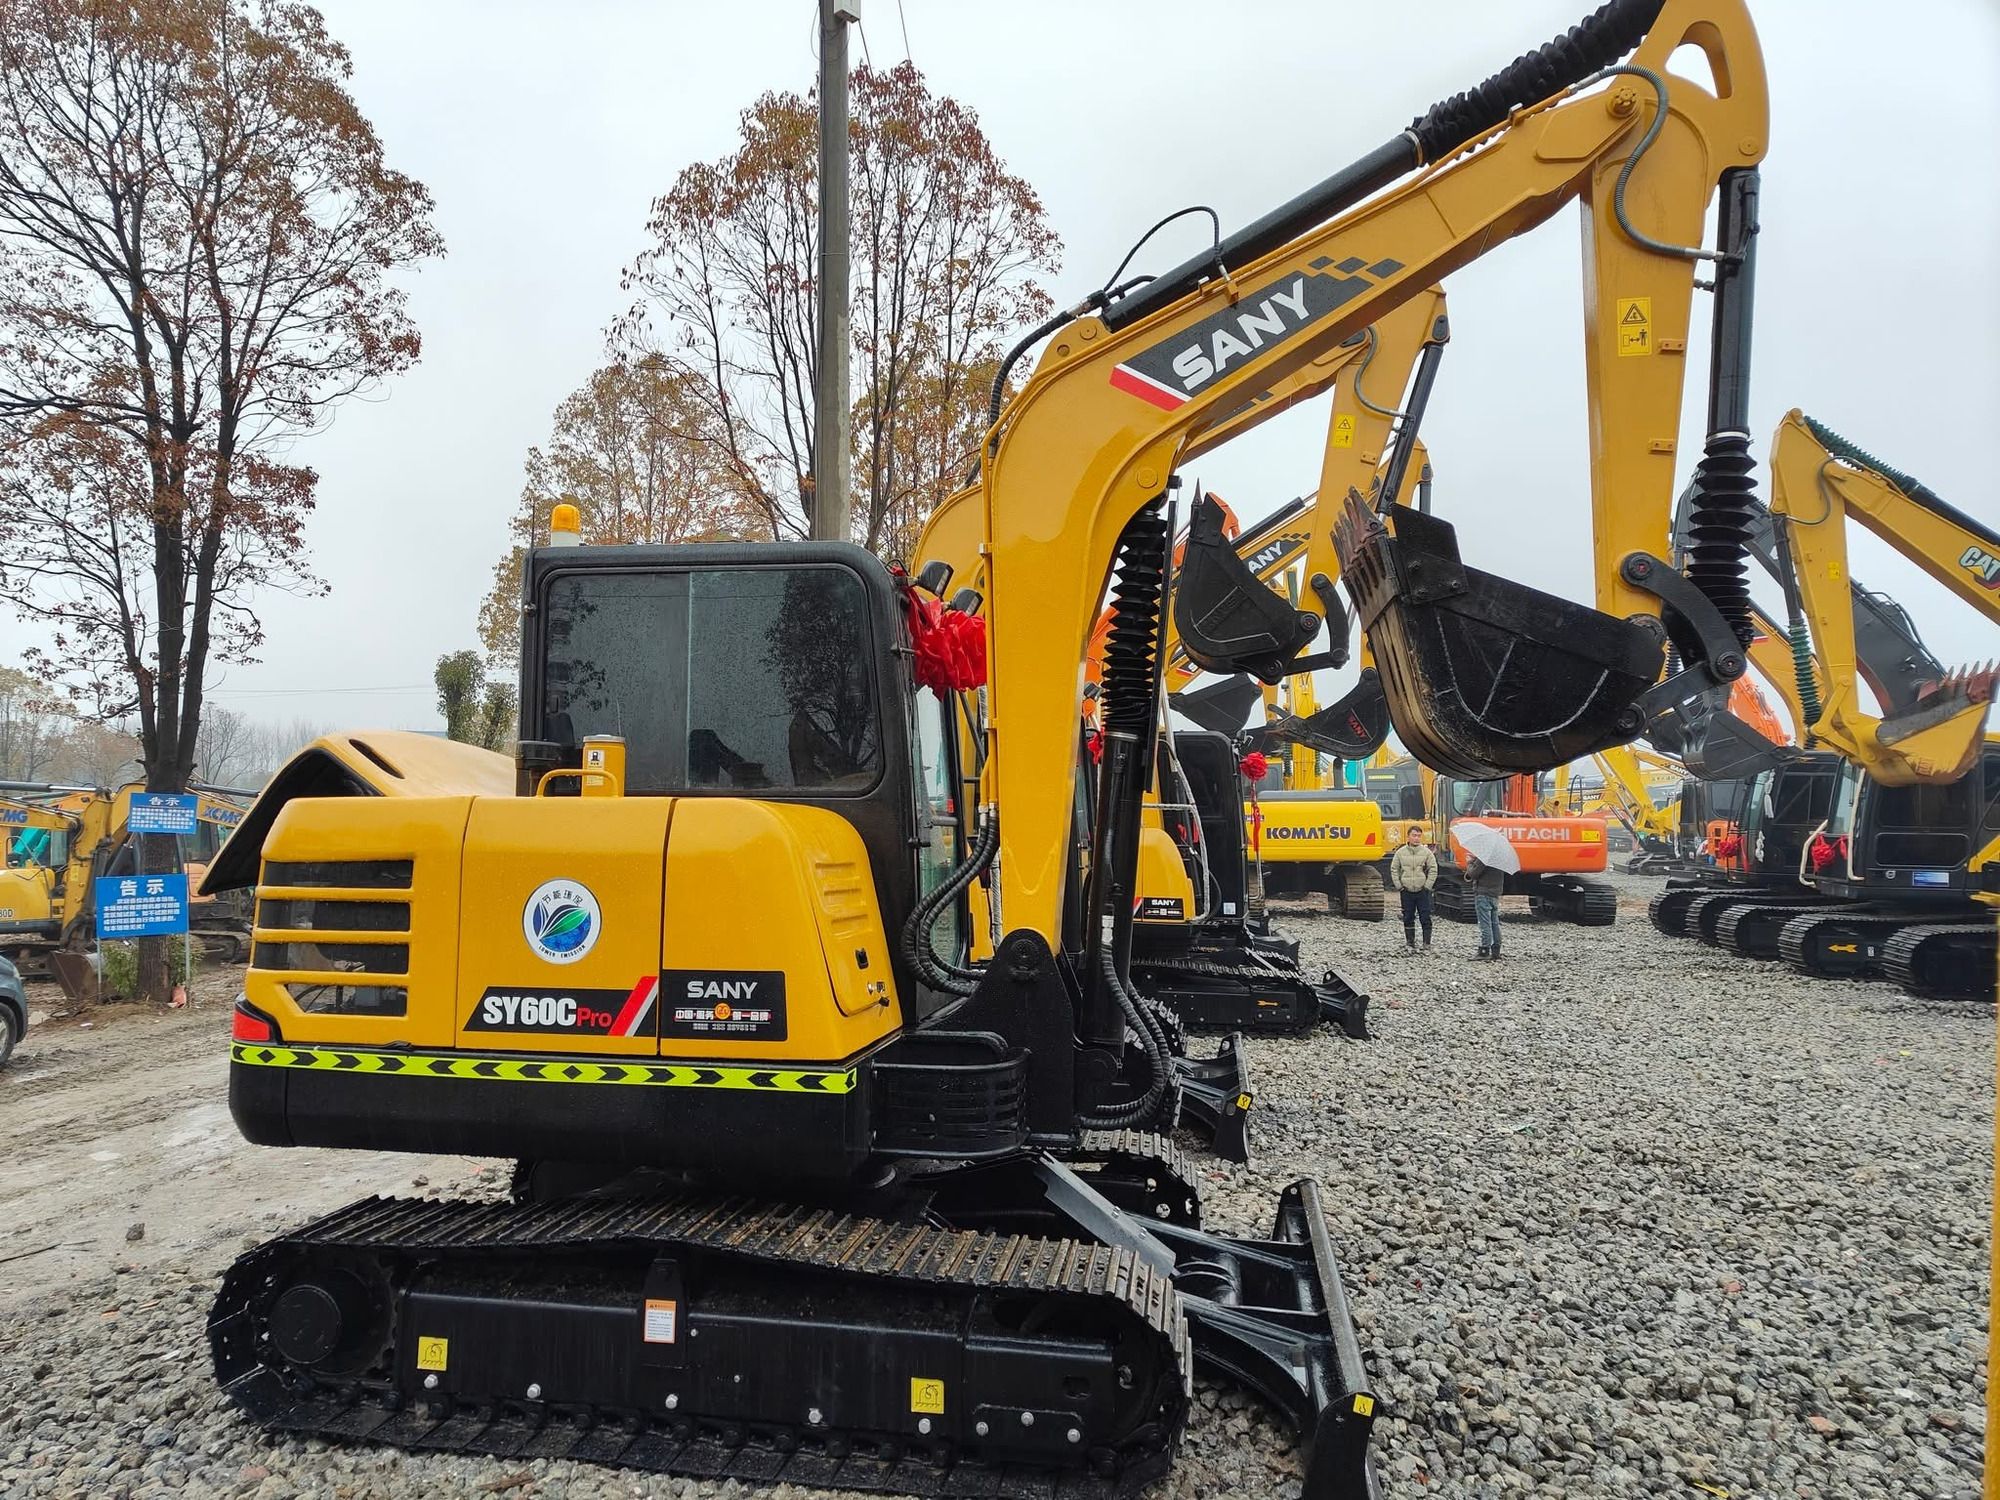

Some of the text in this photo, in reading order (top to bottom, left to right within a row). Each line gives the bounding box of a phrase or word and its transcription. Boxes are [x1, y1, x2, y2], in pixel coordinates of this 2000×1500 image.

[1172, 277, 1310, 391] SANY
[1247, 540, 1284, 574] ANY
[1960, 546, 2000, 581] CAT
[1266, 824, 1351, 840] KOMATSU
[120, 879, 164, 896] 告示
[687, 980, 758, 999] SANY
[482, 996, 613, 1028] SY60C Pro
